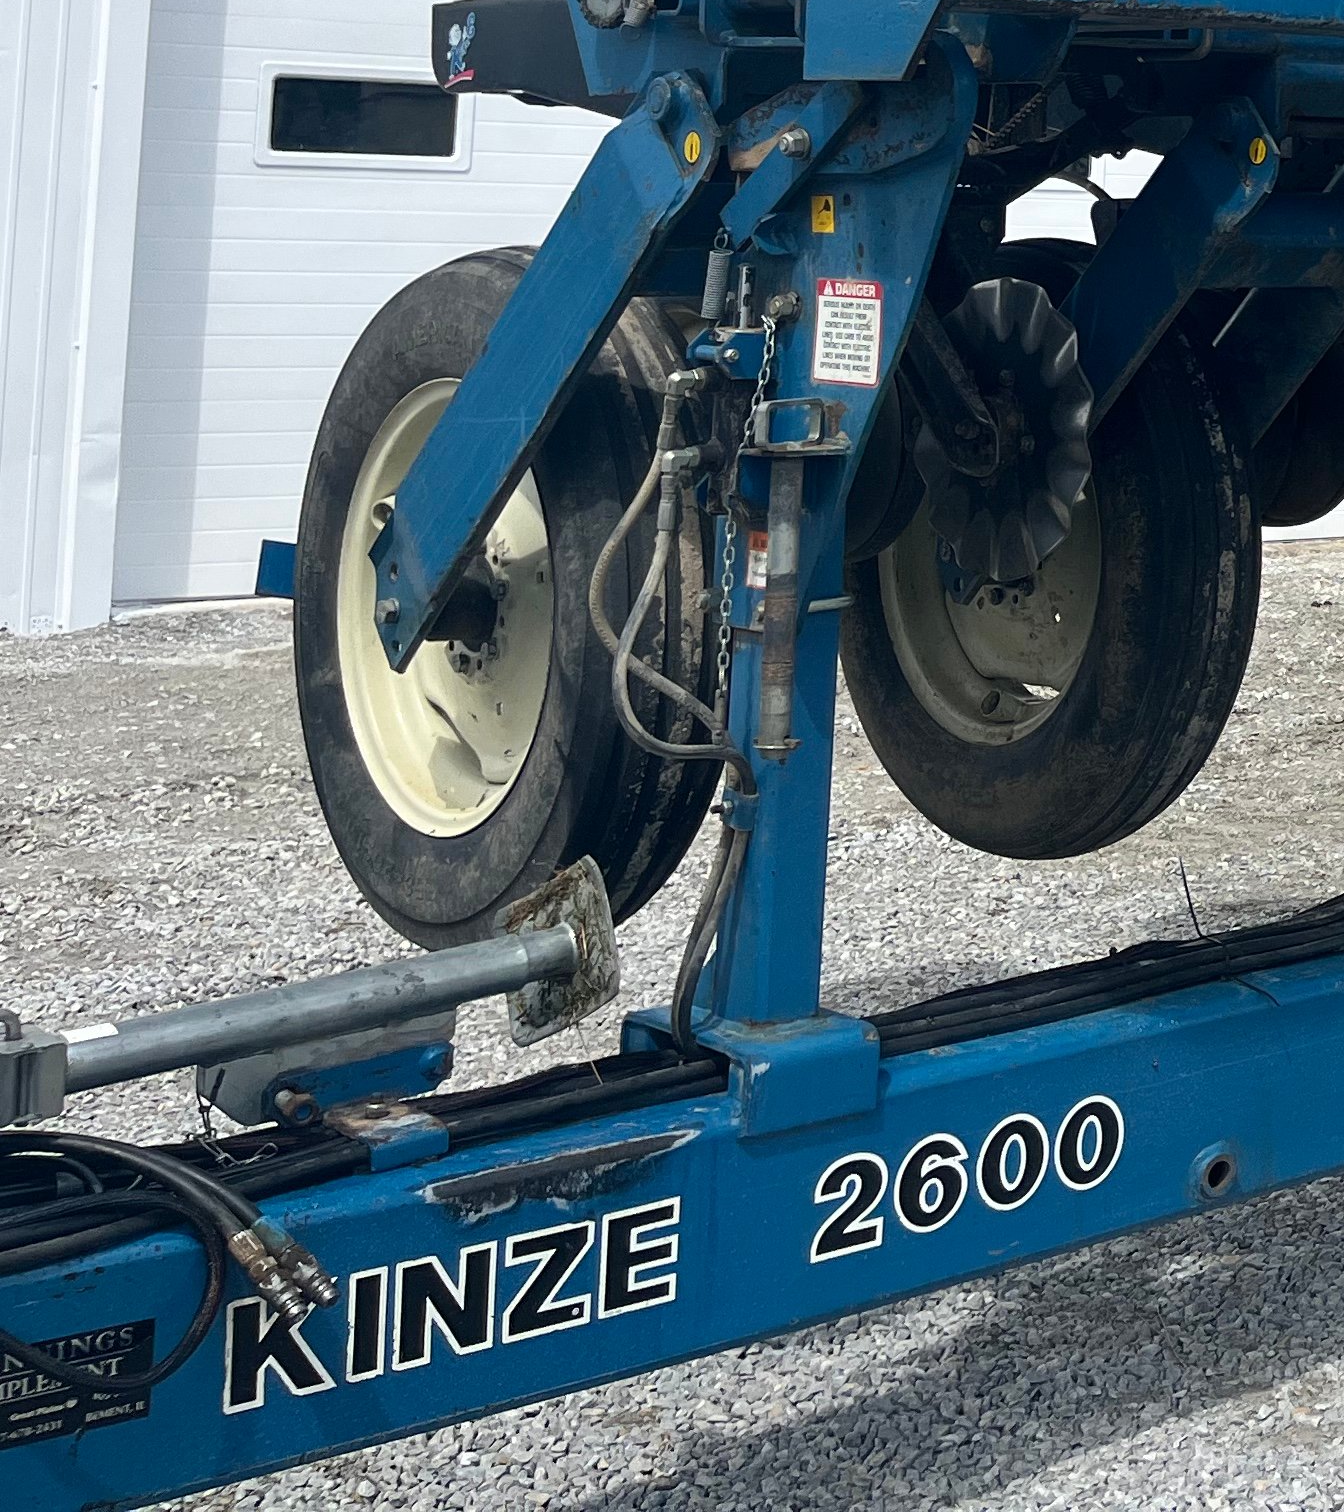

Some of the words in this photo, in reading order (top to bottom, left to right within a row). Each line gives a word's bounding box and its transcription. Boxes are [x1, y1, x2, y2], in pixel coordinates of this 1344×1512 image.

[835, 282, 876, 298] DANGER
[810, 1094, 1125, 1264] 2600
[223, 1196, 681, 1416] KINZE
